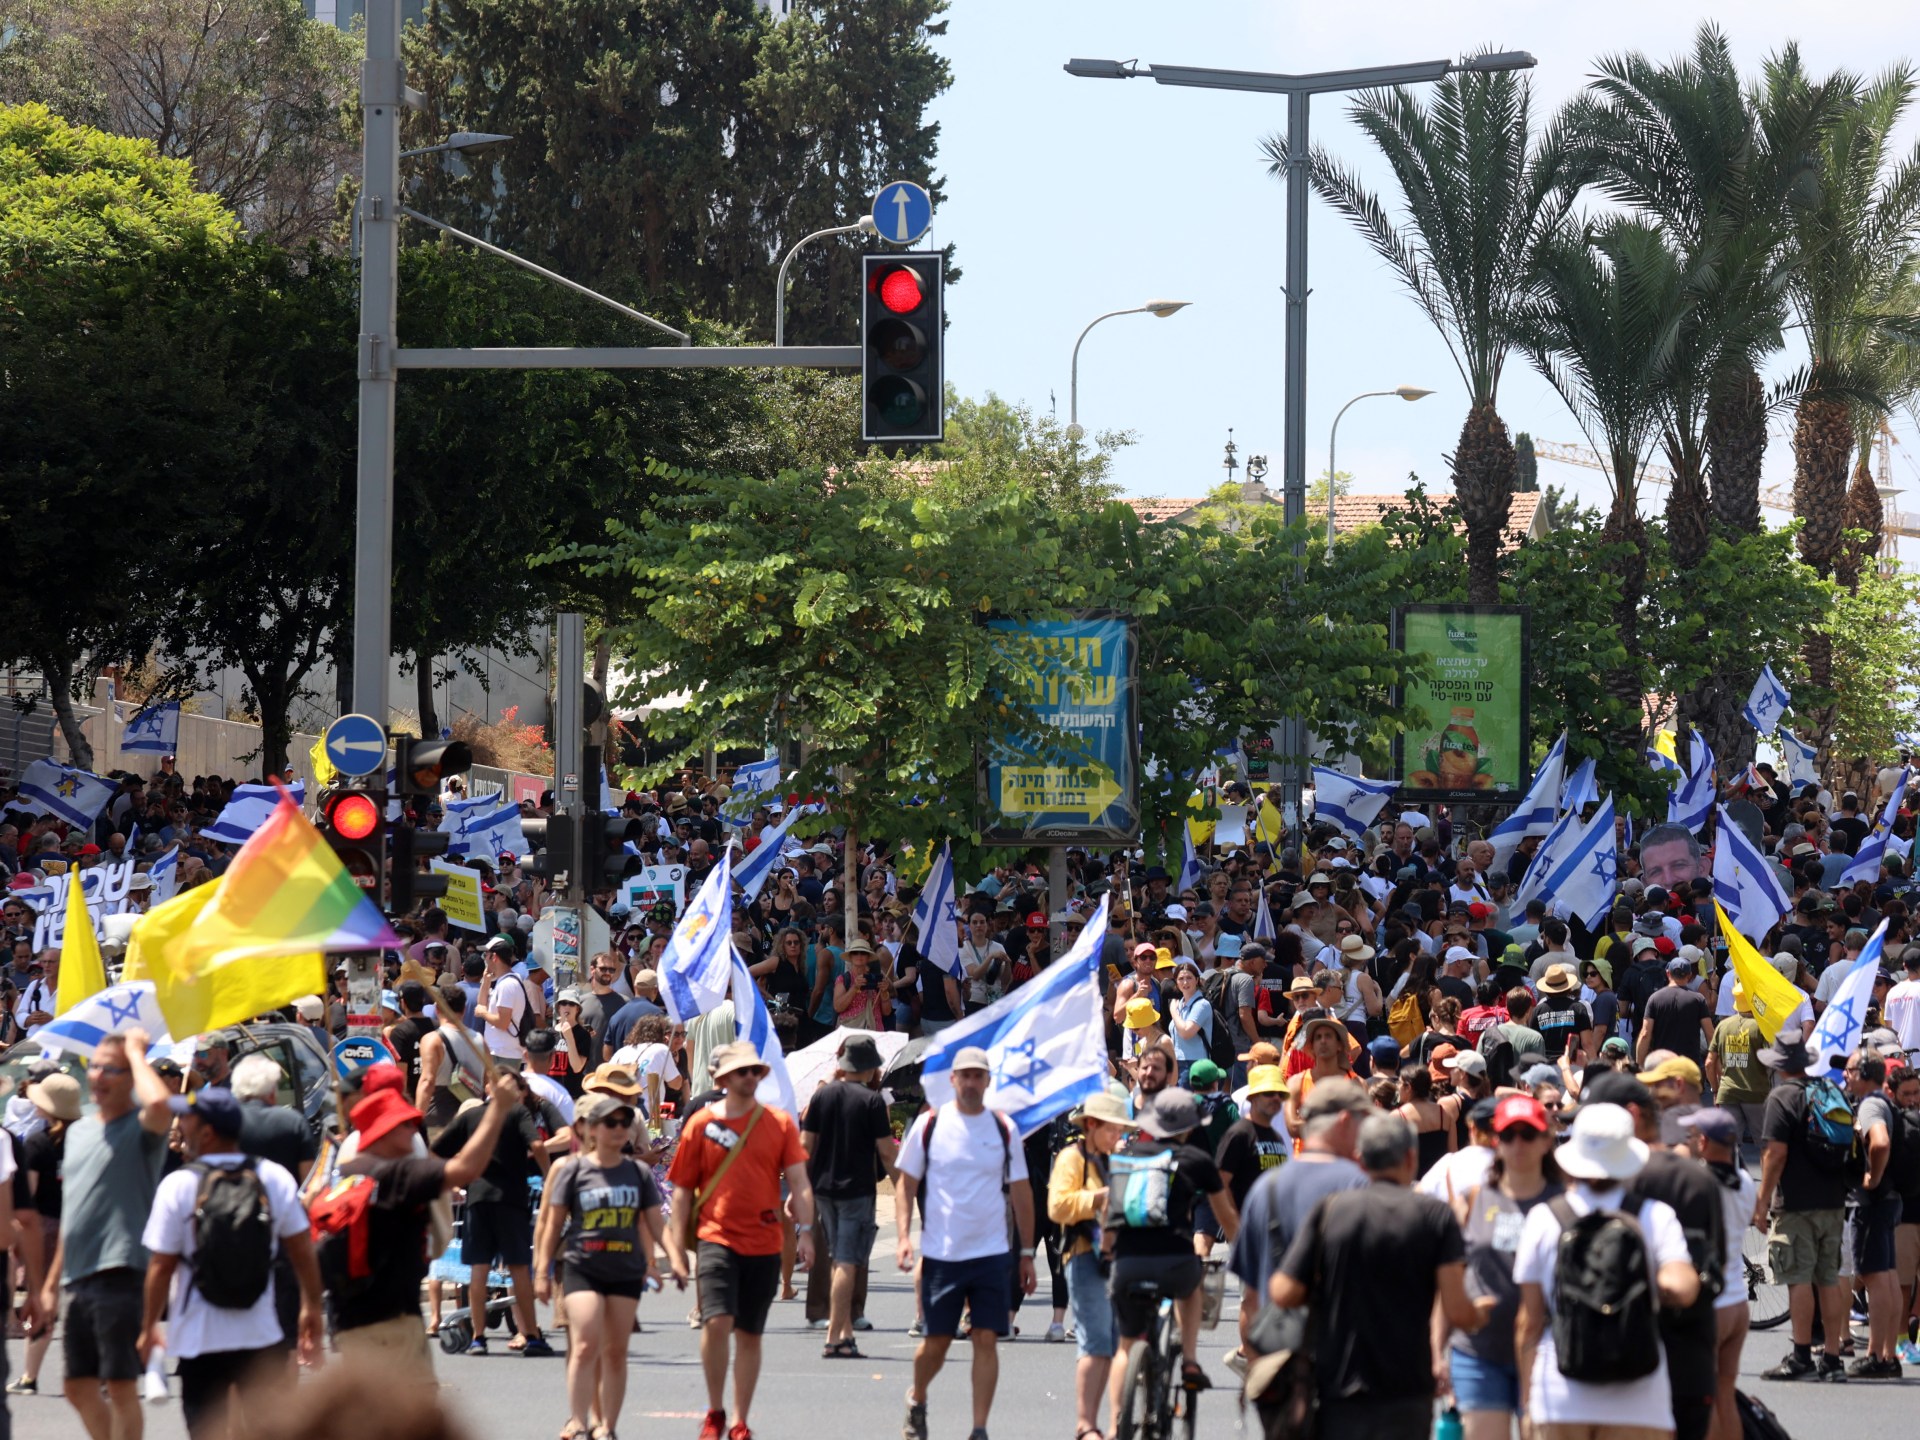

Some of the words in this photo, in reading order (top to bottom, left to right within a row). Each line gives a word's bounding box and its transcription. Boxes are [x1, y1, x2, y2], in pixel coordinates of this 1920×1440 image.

[1436, 657, 1472, 667] שתצאו
[1475, 658, 1488, 668] עד
[1445, 669, 1479, 679] לרגילה
[1429, 680, 1470, 692] הפסקה
[1474, 681, 1494, 693] קחו
[1431, 690, 1472, 702] פיוז-טי!
[1476, 692, 1492, 702] עם
[1048, 711, 1116, 728] המשתלם
[1008, 773, 1051, 788] ימינה
[1024, 791, 1087, 806] במנהרה
[1046, 830, 1079, 838] JCDecaux
